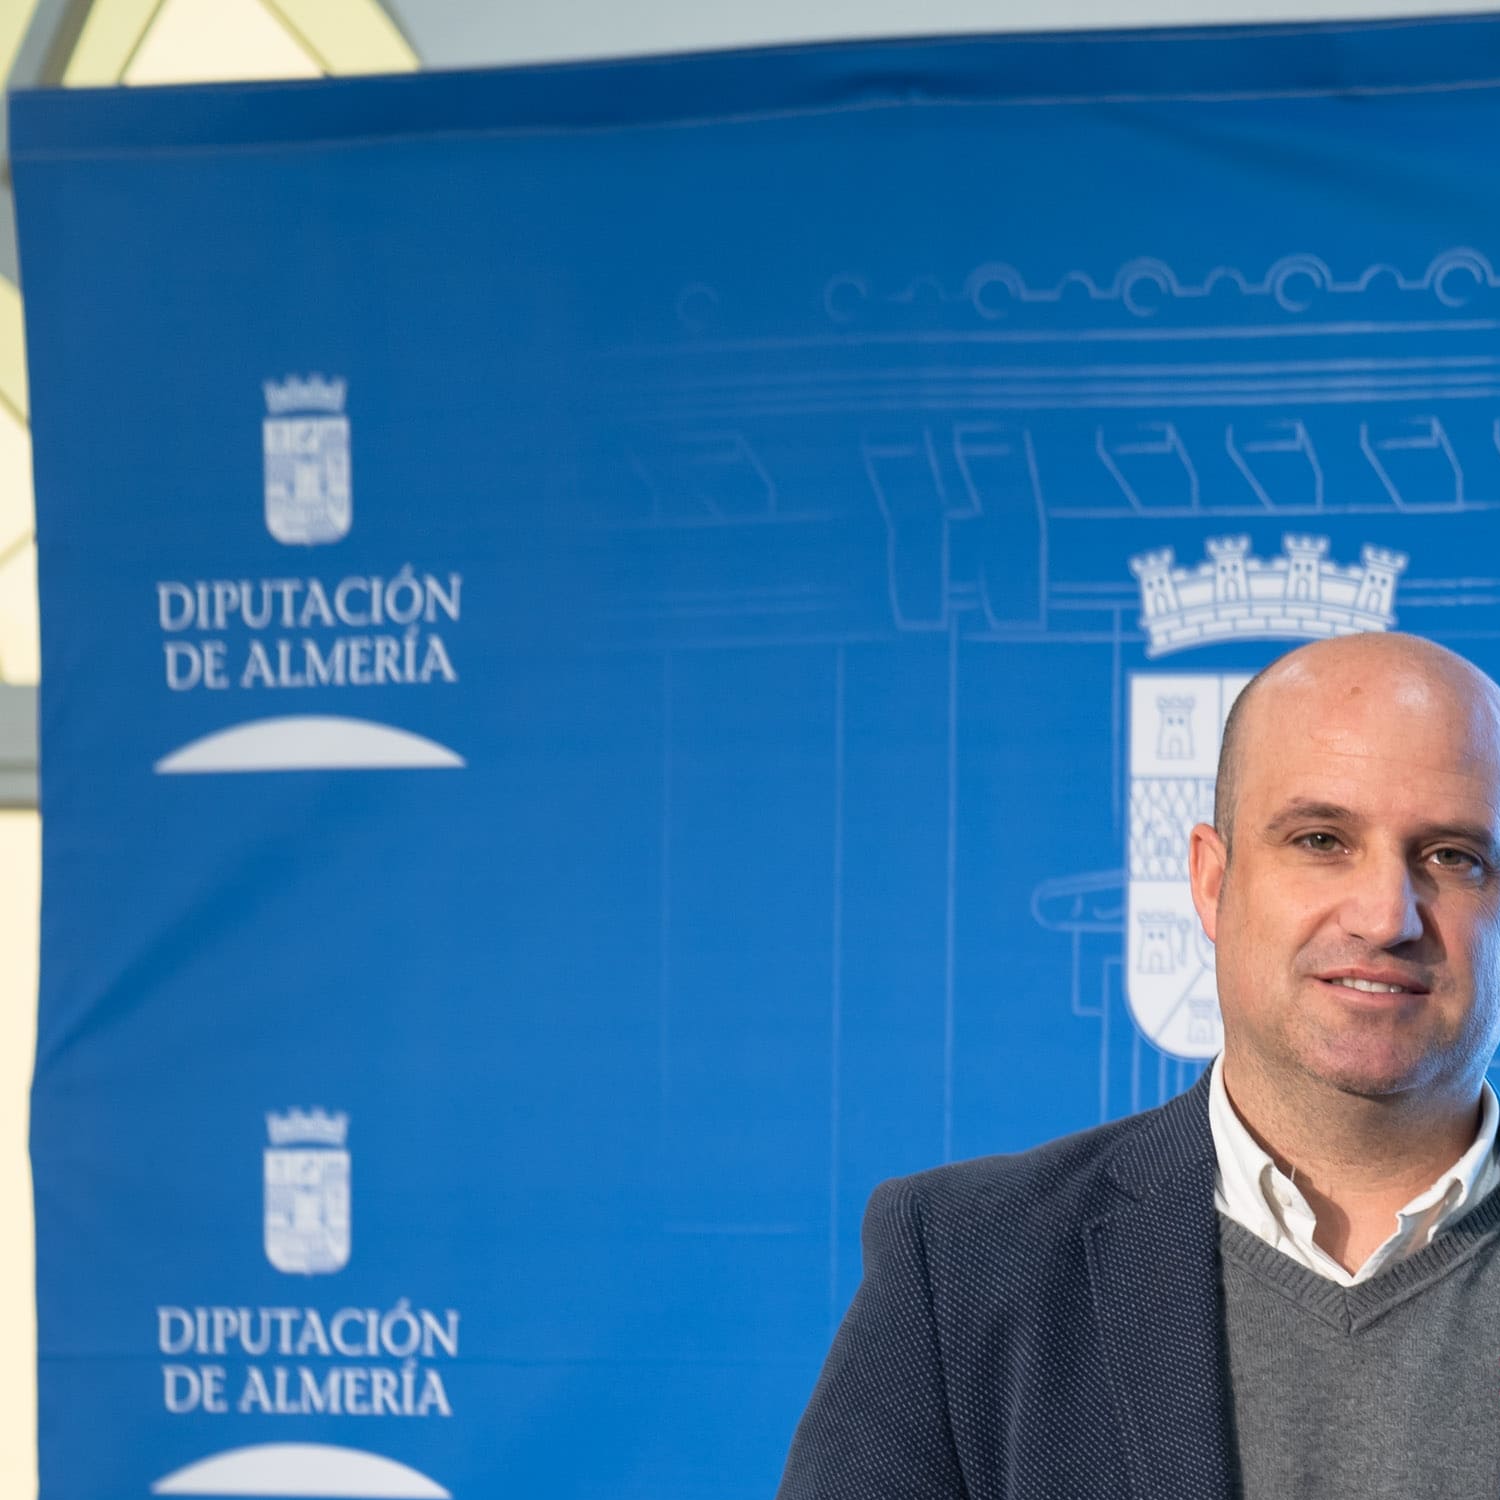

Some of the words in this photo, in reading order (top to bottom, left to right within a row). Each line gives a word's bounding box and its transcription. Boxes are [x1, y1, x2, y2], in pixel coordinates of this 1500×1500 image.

[157, 563, 461, 631] DIPUTACIÓN
[164, 641, 229, 690] DE
[240, 625, 457, 688] ALMERÍA
[157, 1294, 460, 1358] DIPUTACIÓN
[162, 1365, 229, 1414] DE
[239, 1358, 453, 1417] ALMERÍA
